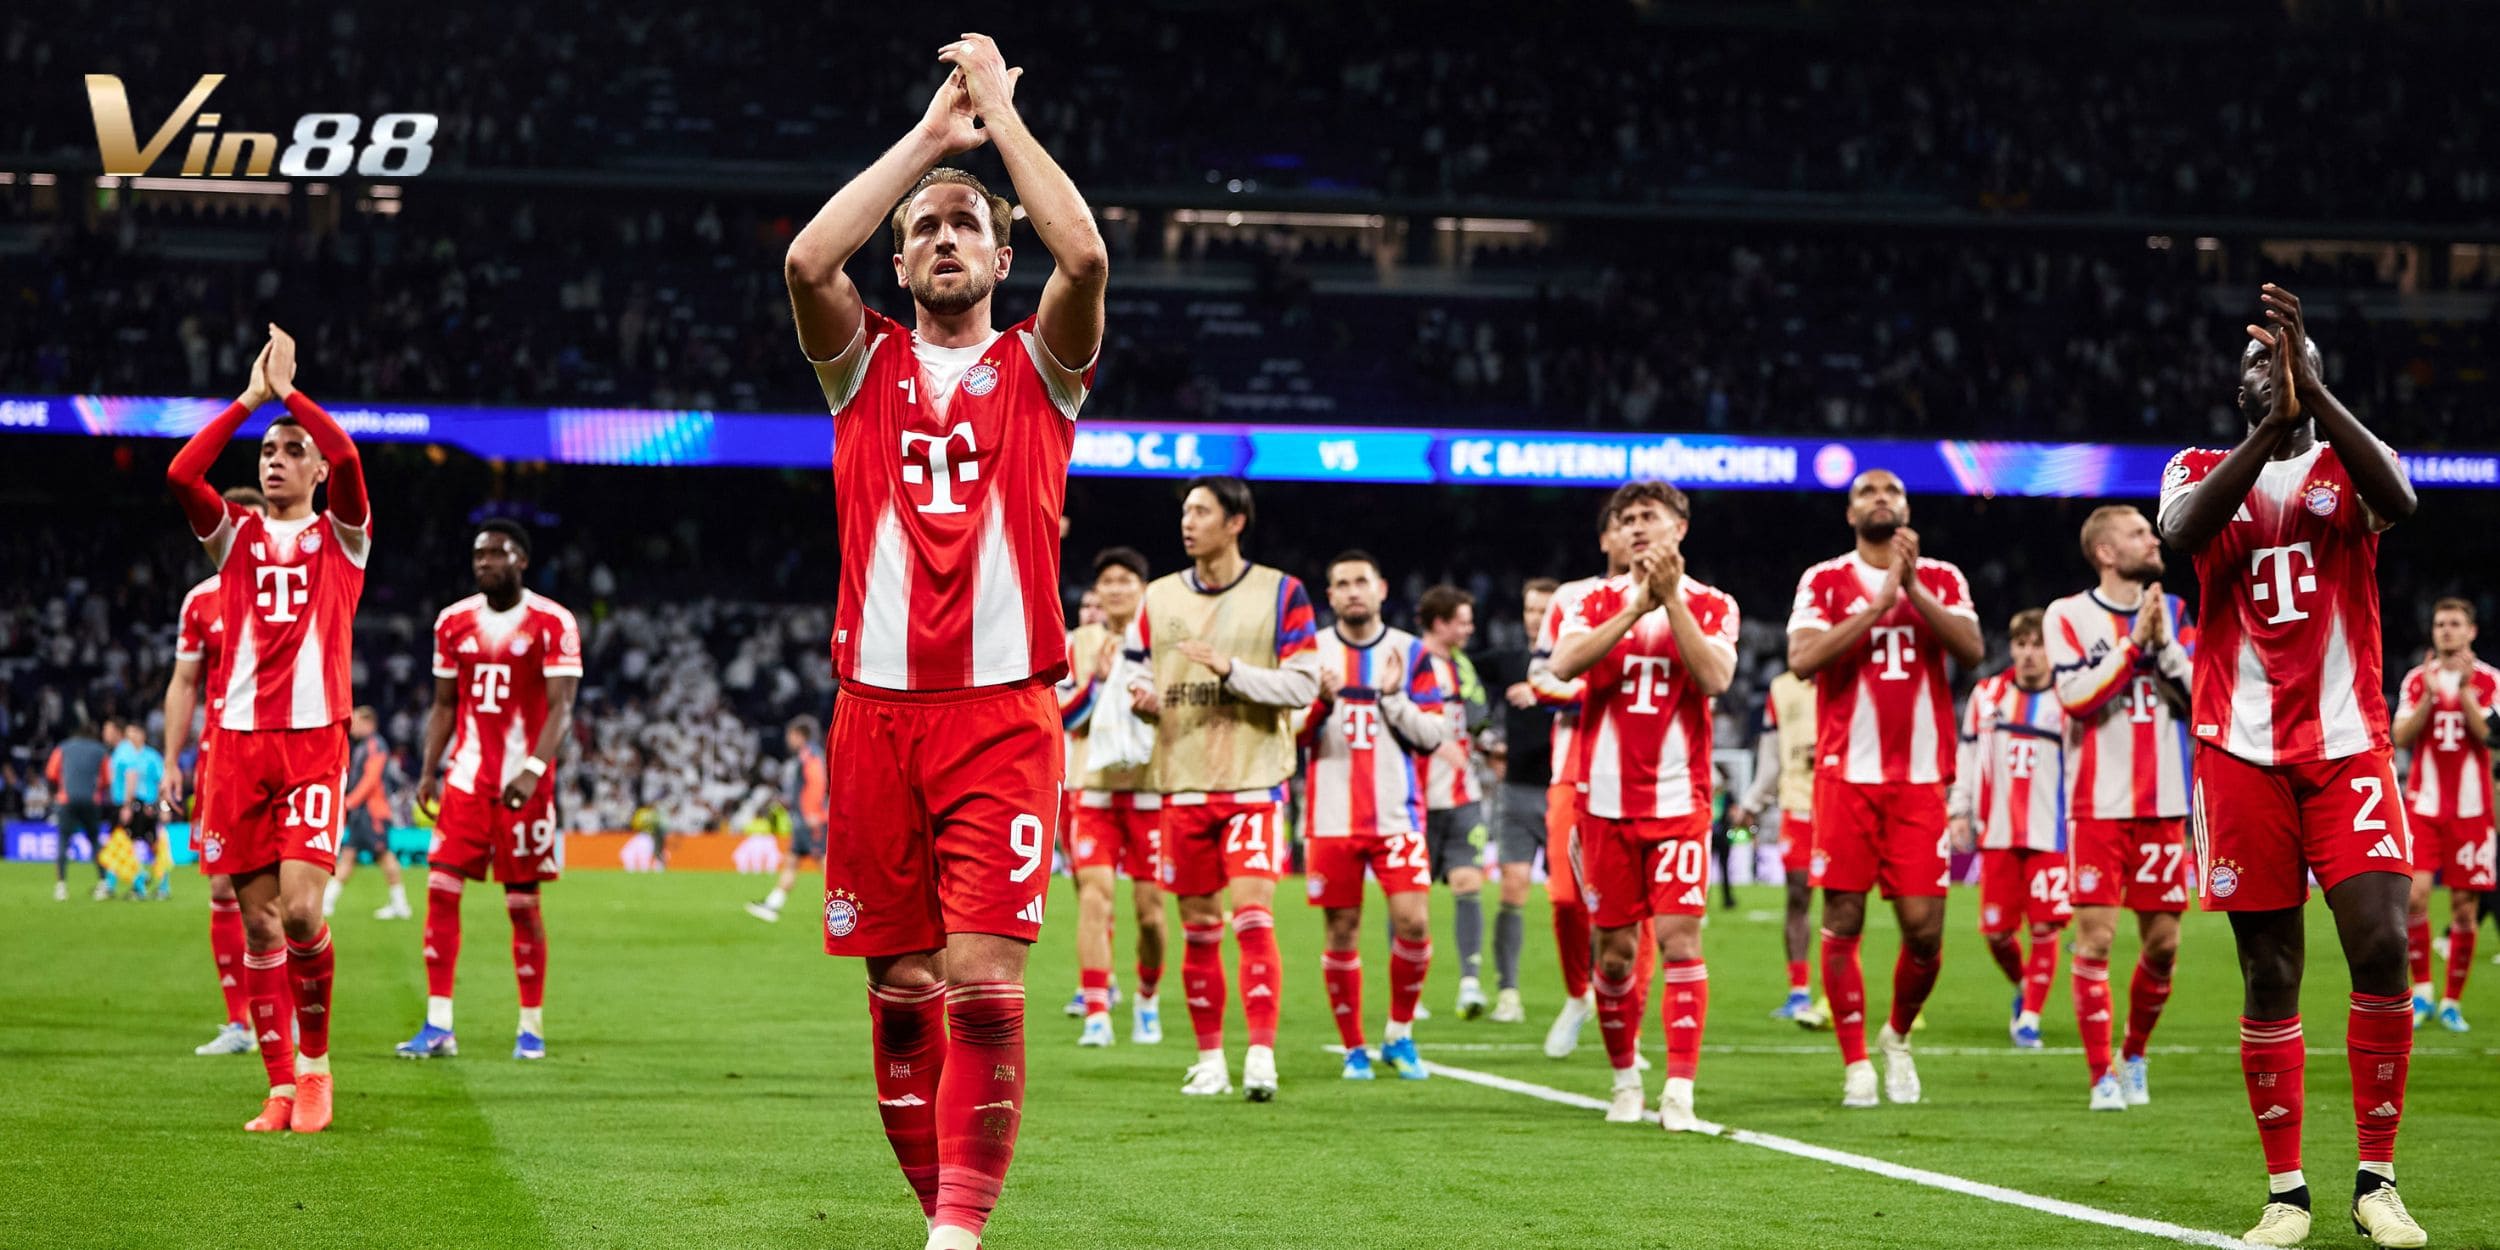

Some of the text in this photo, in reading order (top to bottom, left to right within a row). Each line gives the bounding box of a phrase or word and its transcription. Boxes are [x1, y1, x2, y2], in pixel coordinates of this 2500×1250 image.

[1450, 437, 1797, 483] FC BAYERN MÜNCHEN
[2413, 457, 2496, 483] LEAGUE
[285, 784, 331, 828] 10
[2350, 776, 2387, 832] 2
[512, 818, 553, 858] 19
[1009, 813, 1043, 883] 9
[1226, 812, 1267, 854] 21
[1386, 831, 1427, 868] 22
[1654, 839, 1703, 884] 20
[2136, 842, 2184, 883] 27
[2456, 838, 2493, 874] 44
[2030, 866, 2069, 903] 42
